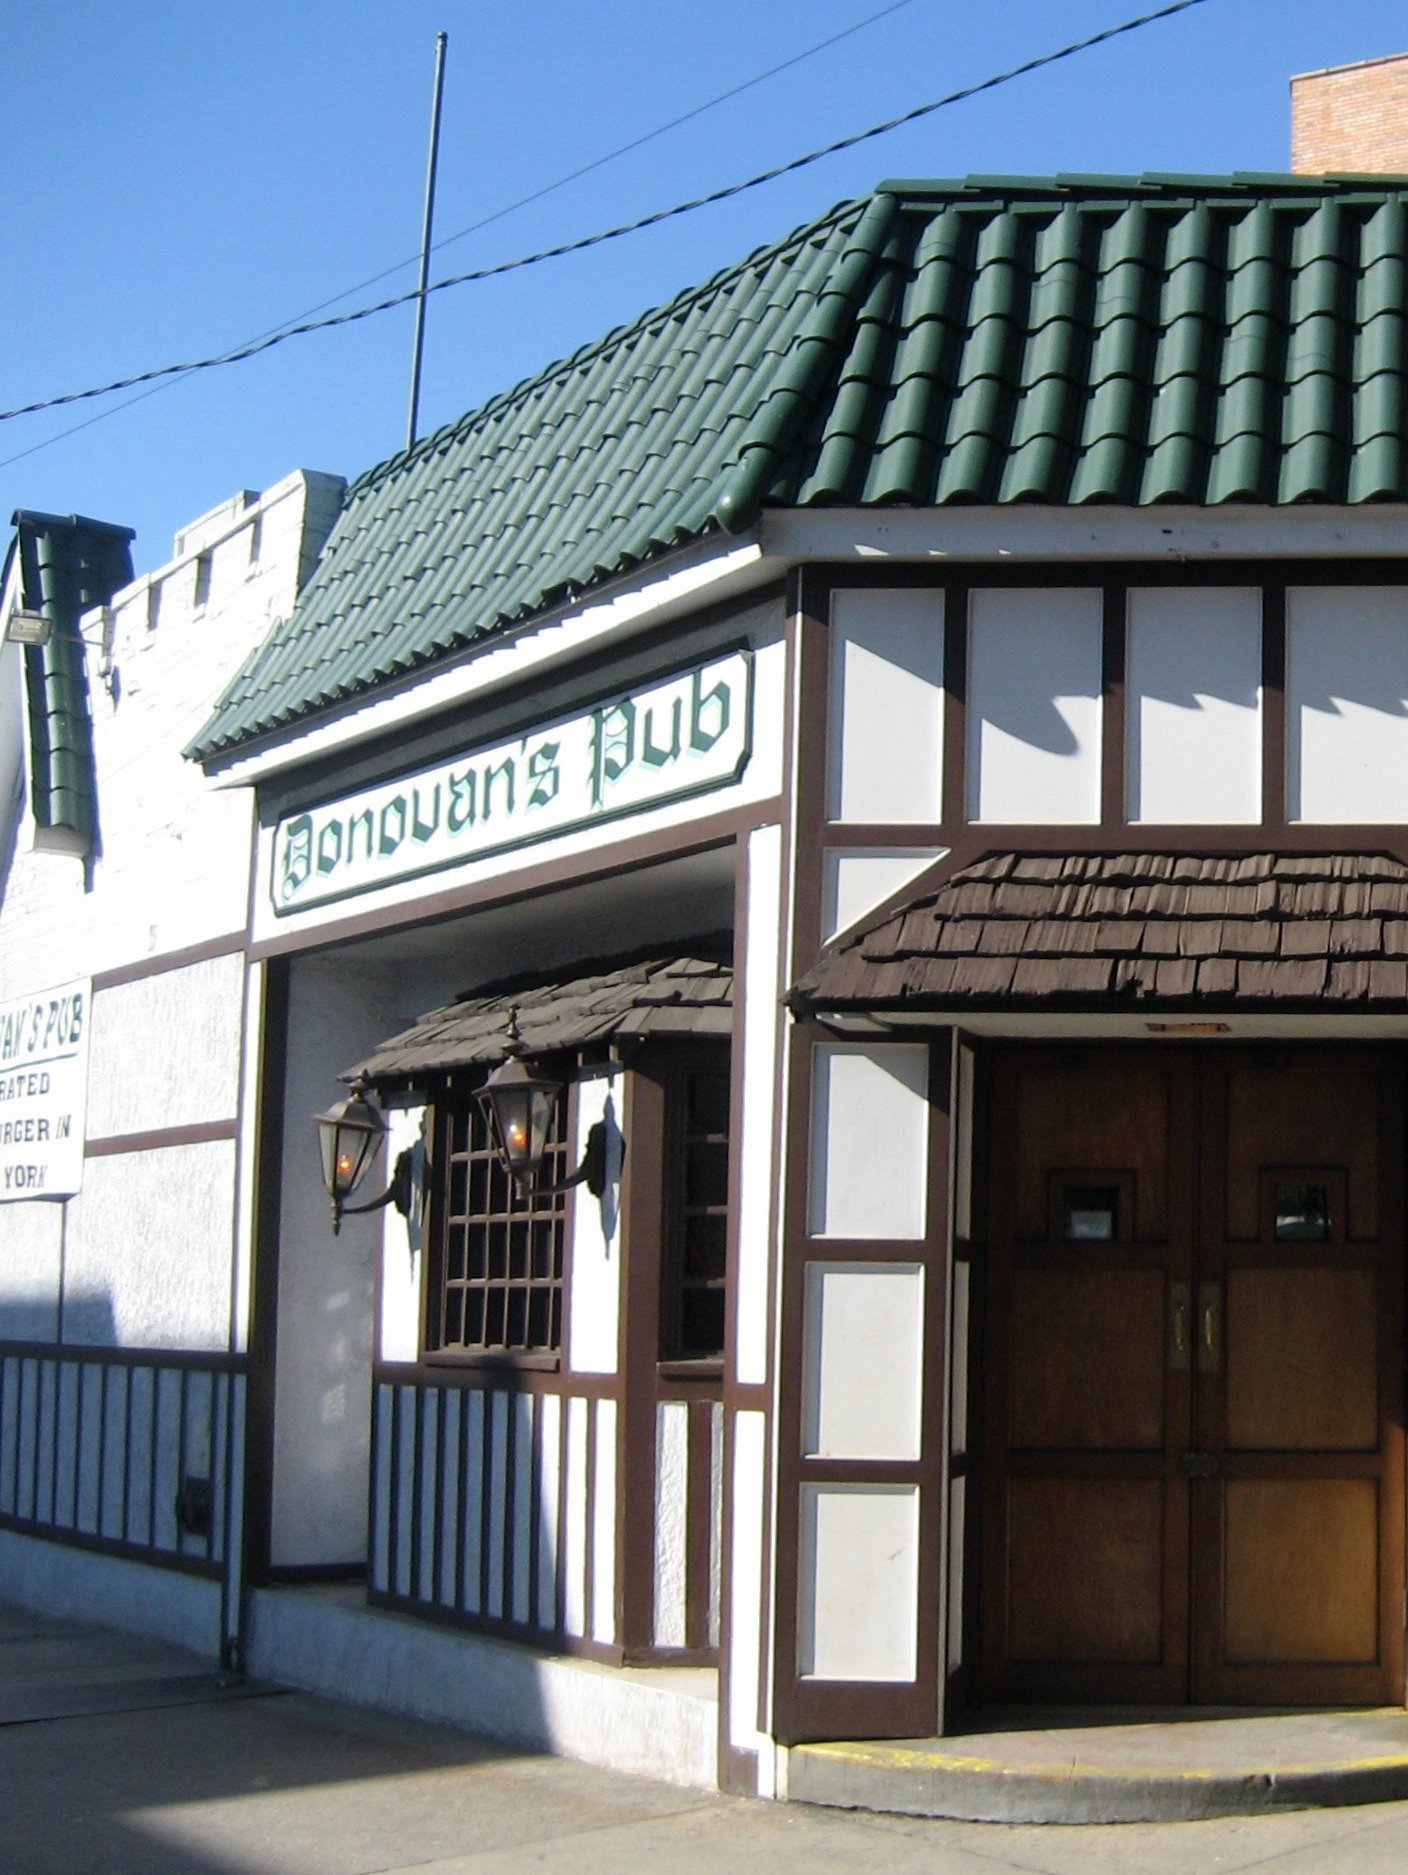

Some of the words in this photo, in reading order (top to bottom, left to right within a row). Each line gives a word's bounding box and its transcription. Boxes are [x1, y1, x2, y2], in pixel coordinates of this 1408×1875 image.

[282, 736, 561, 901] Donovan's
[586, 670, 731, 810] Pub
[43, 993, 83, 1049] PUB
[55, 1114, 71, 1139] IN
[5, 1164, 48, 1189] YORK
